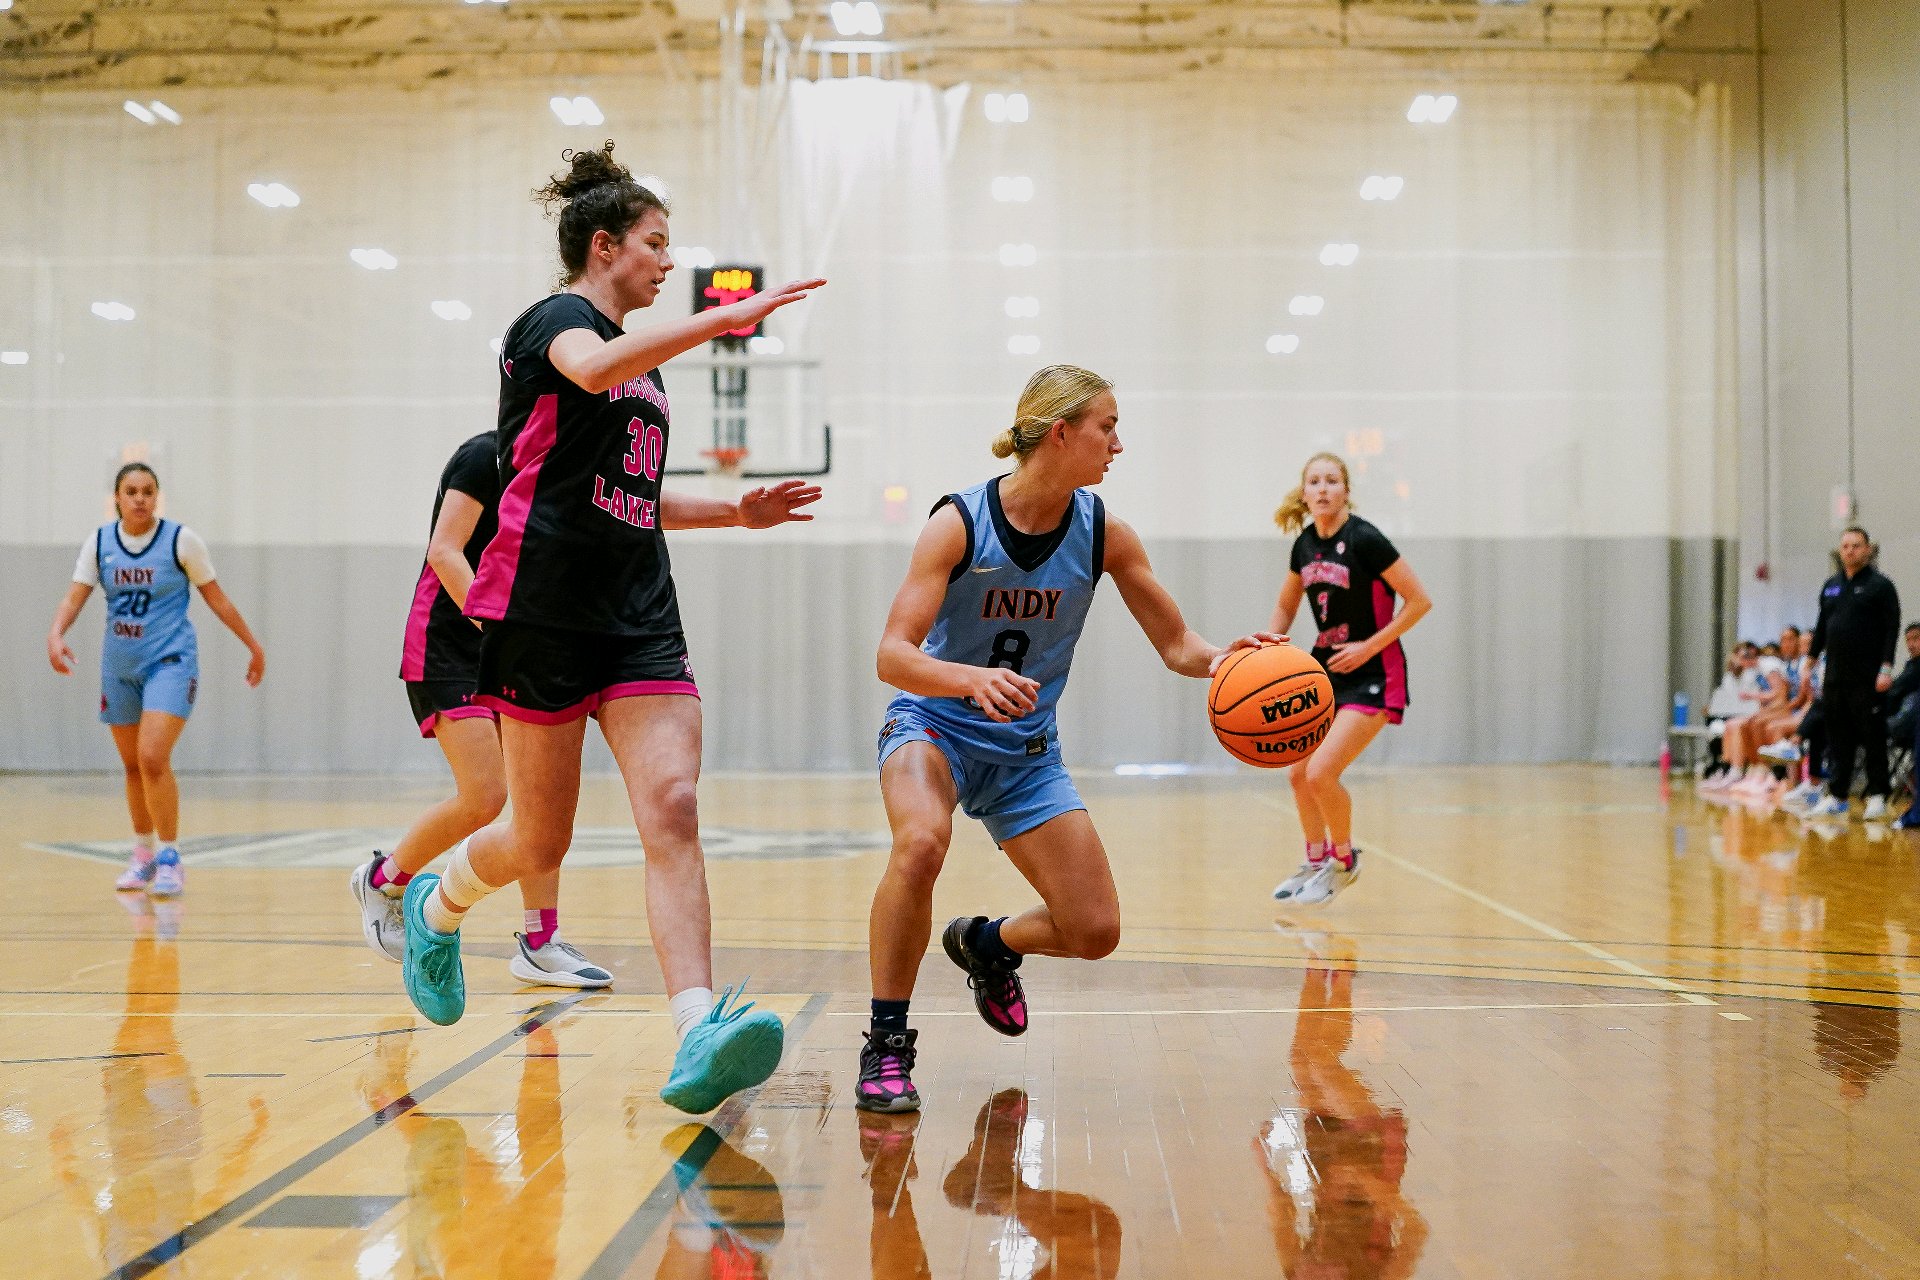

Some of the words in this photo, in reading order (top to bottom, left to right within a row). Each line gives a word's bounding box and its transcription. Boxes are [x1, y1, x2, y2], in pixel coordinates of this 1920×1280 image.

[623, 416, 663, 482] 30
[592, 474, 657, 529] LAKE
[114, 567, 154, 586] INDY
[982, 587, 1064, 621] INDY
[113, 621, 144, 639] ONE
[987, 629, 1031, 676] 8
[1261, 687, 1319, 724] NCAA
[1255, 717, 1331, 753] Wilson
